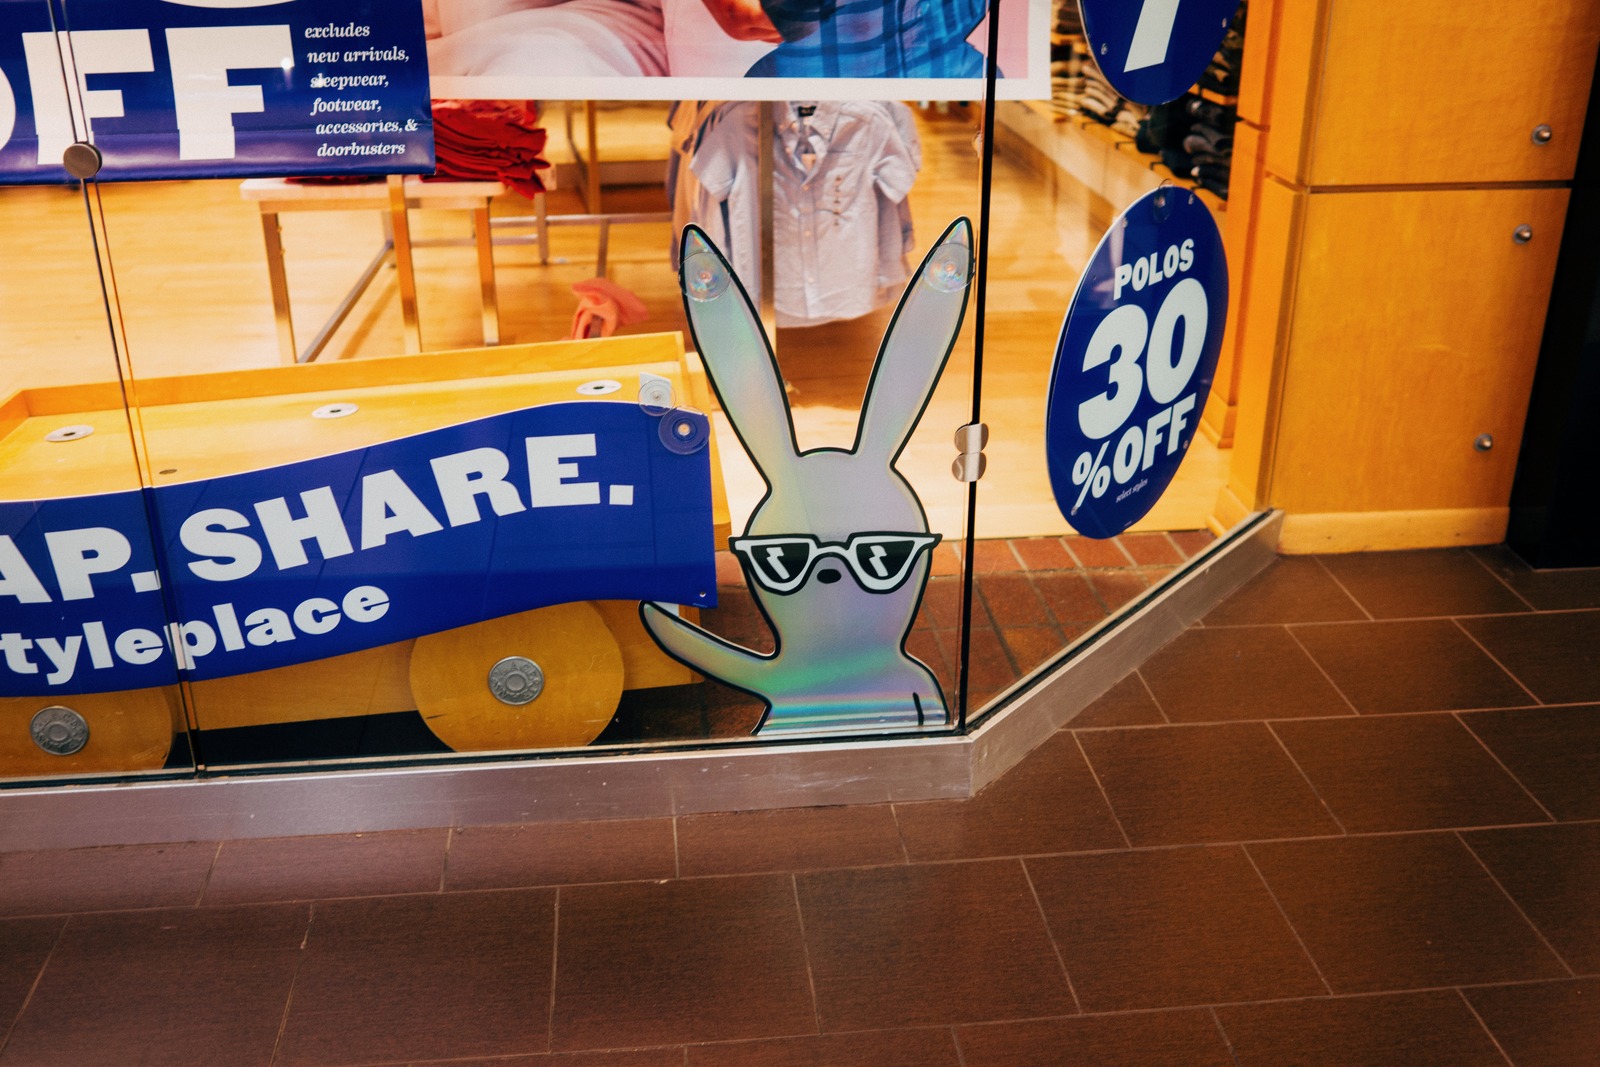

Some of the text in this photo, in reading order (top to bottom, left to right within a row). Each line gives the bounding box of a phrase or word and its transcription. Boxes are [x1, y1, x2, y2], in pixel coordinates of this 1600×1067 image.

[304, 22, 371, 39] excludes
[307, 46, 410, 64] new arrivals,
[310, 73, 389, 91] sleepwear,
[0, 24, 294, 165] FF
[309, 97, 382, 116] footwear,
[315, 118, 418, 135] accessories, &
[317, 142, 406, 157] doorbusters
[1114, 238, 1195, 301] POLOS
[1078, 277, 1209, 440] 30
[179, 433, 634, 582] SHARE.
